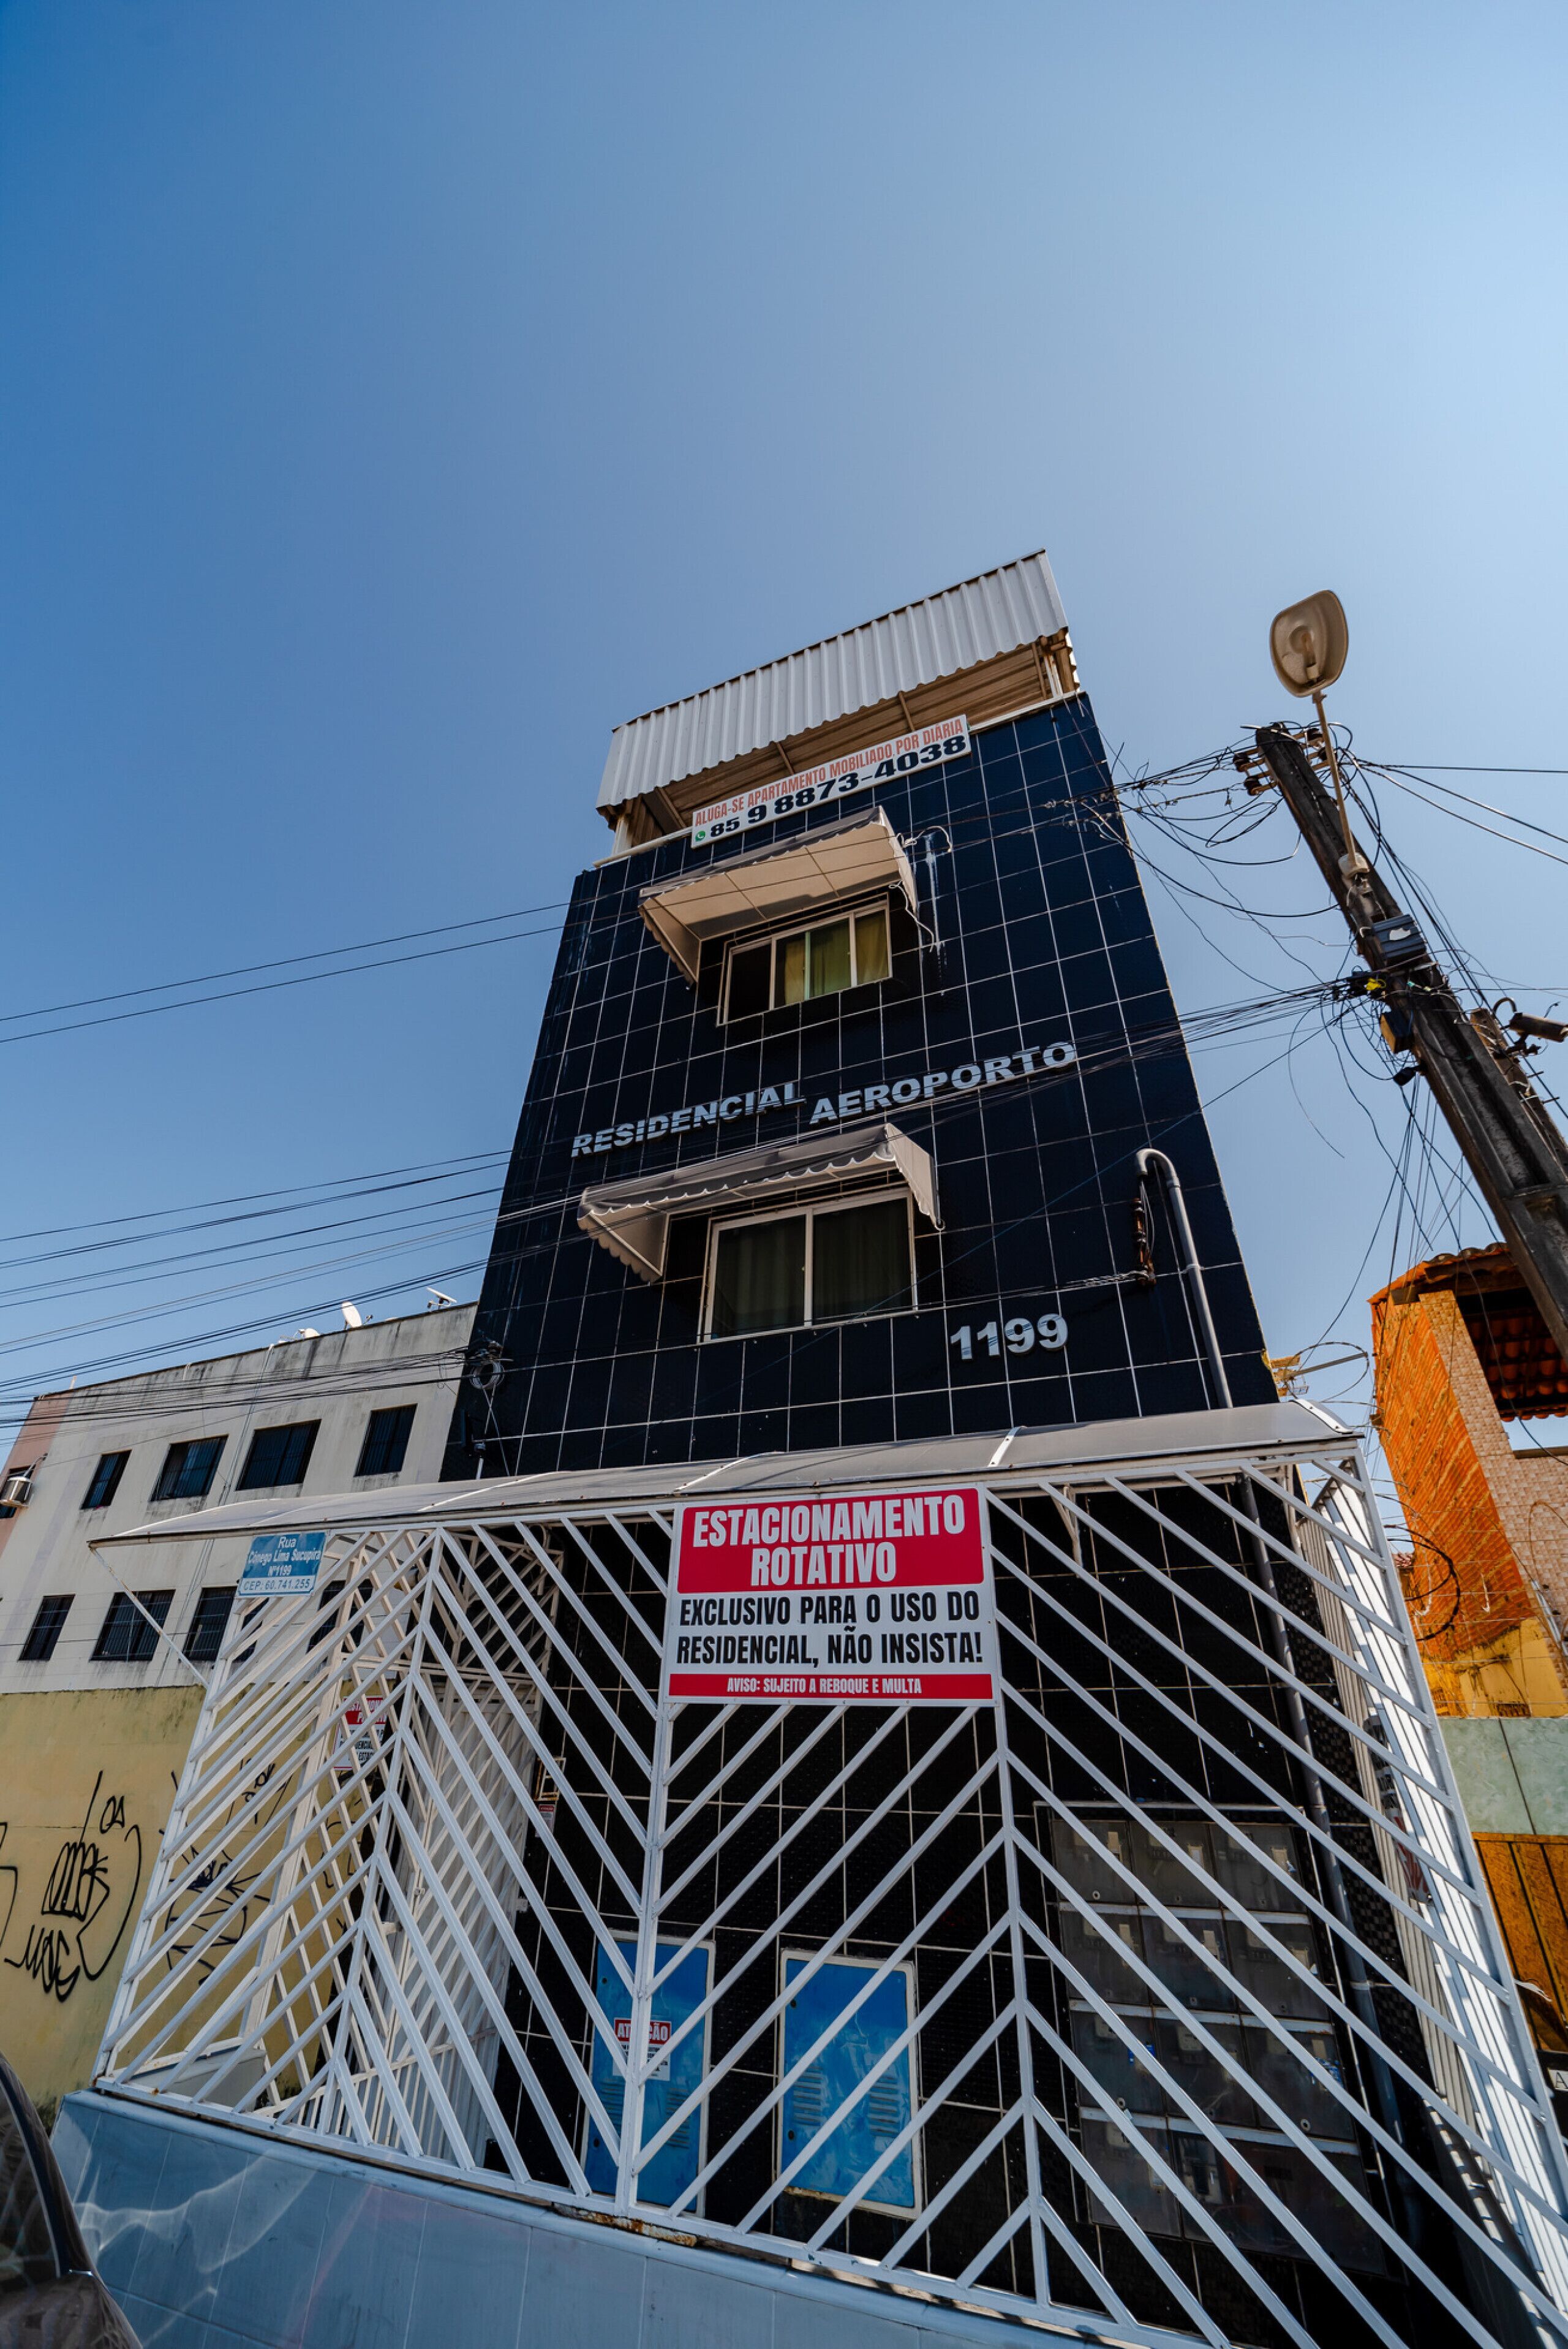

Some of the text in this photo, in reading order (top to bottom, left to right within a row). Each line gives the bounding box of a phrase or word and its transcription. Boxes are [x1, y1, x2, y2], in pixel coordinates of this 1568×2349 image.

[695, 719, 963, 826] ALUGA-SE APARTAMENTO MOBILIADO POR DIÁRIA
[710, 736, 967, 838] 85 9 8873-4038
[570, 1041, 1076, 1159] RESIDENCIAL AEROPORTO
[950, 1313, 1068, 1360] 1199
[277, 1537, 296, 1549] Rua
[693, 1495, 965, 1548] ESTACIONAMENTO
[273, 1549, 290, 1562] Lima
[291, 1548, 322, 1564] Sucupira
[751, 1541, 896, 1587] ROTATIVO
[680, 1591, 979, 1627] EXCLUSIVO PARA O USO DO
[676, 1625, 983, 1668] RESIDENCIAL, NÃO INSISTA!
[727, 1677, 922, 1695] AVISO: SUJEITO A REBOQUE E MULTA
